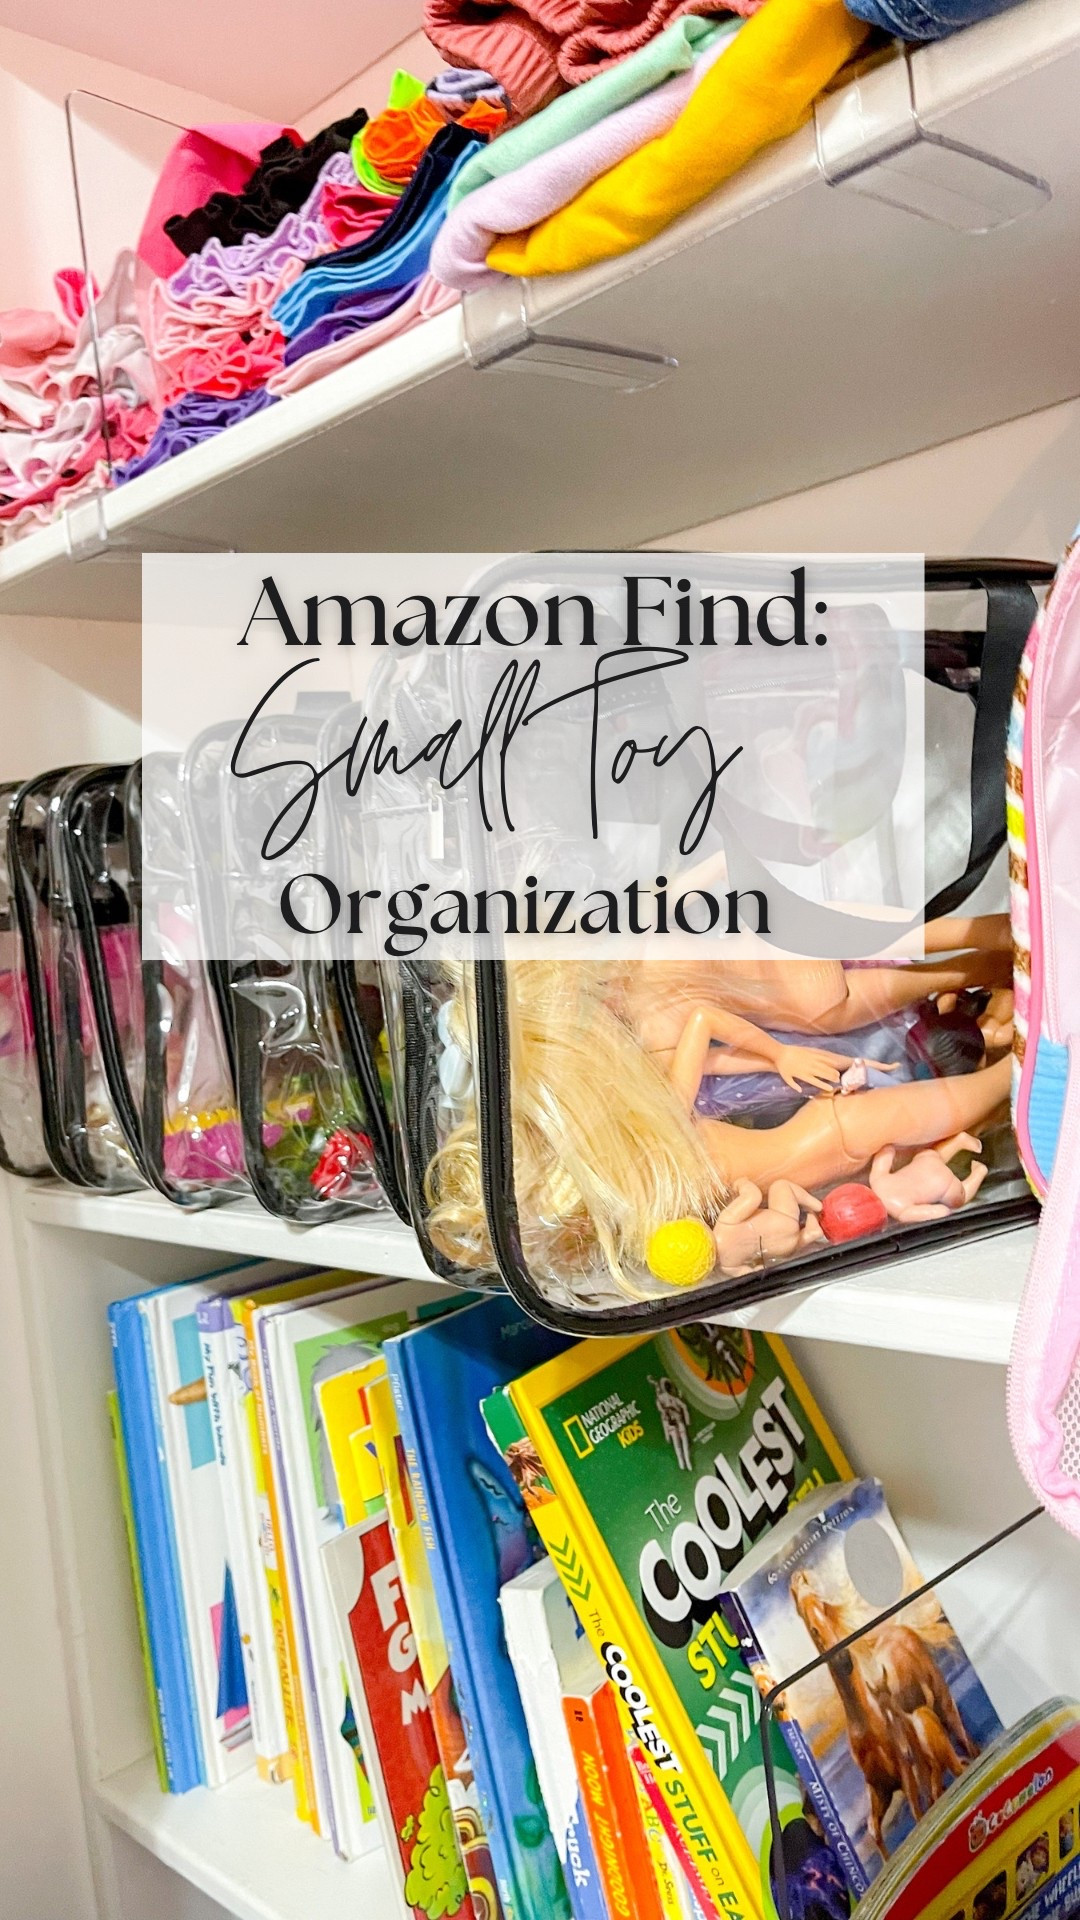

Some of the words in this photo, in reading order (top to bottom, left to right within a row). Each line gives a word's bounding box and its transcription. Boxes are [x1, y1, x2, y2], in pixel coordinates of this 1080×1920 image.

[391, 1373, 404, 1411] Pfister
[580, 1392, 625, 1429] NATIONAL
[588, 1400, 642, 1445] GEOGRAPHIC
[616, 1419, 645, 1449] KIDS
[406, 1448, 418, 1467] THE
[411, 1472, 430, 1521] RAINBOW
[639, 1376, 806, 1623] COOLEST
[644, 1492, 682, 1533] The
[421, 1523, 436, 1550] FISH
[687, 1610, 741, 1690] STU
[588, 1608, 605, 1637] The
[601, 1642, 684, 1774] COOLEST
[665, 1779, 718, 1863] STUFF
[711, 1866, 725, 1886] on
[580, 1751, 606, 1806] MOON
[593, 1809, 631, 1917] GOODNIGHT
[837, 1840, 865, 1897] CHINCO
[1044, 1859, 1080, 1908] WHEEL
